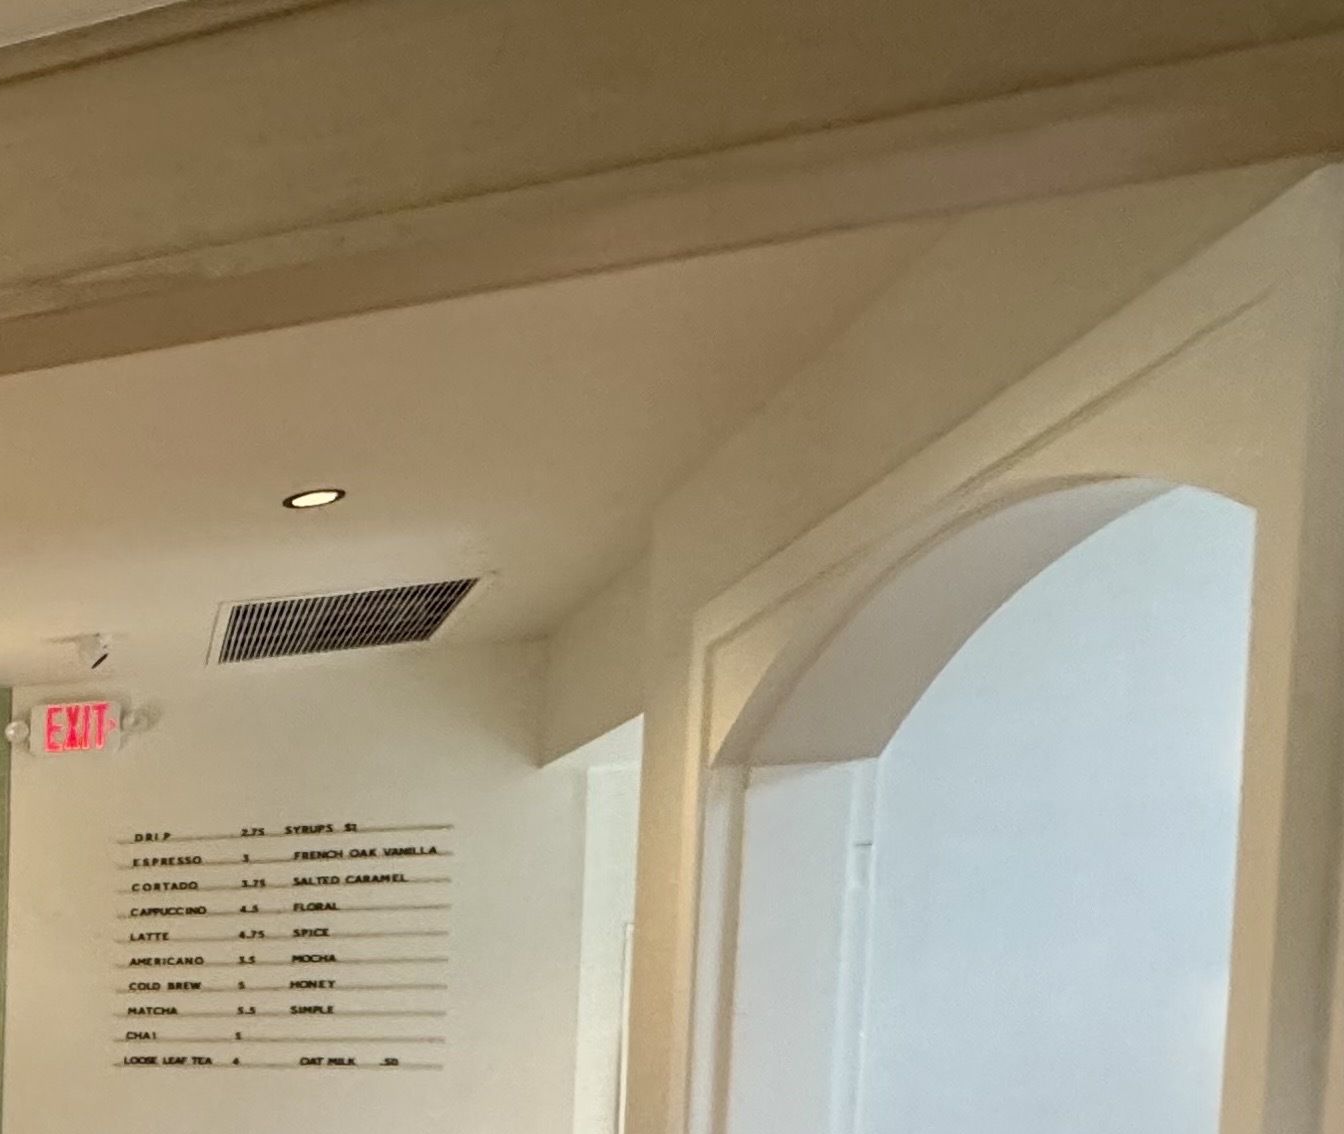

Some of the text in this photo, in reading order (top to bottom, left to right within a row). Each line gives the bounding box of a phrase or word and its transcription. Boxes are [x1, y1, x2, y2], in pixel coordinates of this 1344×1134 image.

[45, 703, 109, 752] EXIT
[284, 824, 333, 834] SYRUPS
[134, 828, 265, 842] DRIP 2.75
[293, 846, 438, 860] FRENCH OAK VANILLA
[132, 854, 250, 867] ESPRESSO 3
[292, 874, 408, 886] SALTED CARAMEL
[131, 879, 266, 892] CORTADO 3.75
[130, 905, 259, 917] CAPPUCCINO 4.5
[293, 902, 339, 912] FLORAL
[129, 930, 265, 942] LATTE 4.75
[292, 928, 330, 937] SPICE
[129, 957, 204, 966] AMERICANO
[291, 954, 336, 963] MOCHA
[128, 982, 161, 991] COLD
[167, 981, 202, 990] BREW
[289, 980, 336, 989] HONEY
[127, 1006, 178, 1015] MATCHA
[290, 1005, 334, 1014] SIMPLE
[125, 1031, 157, 1040] CHAI
[123, 1056, 158, 1065] LOOSE
[162, 1056, 188, 1065] LEAF
[191, 1056, 213, 1065] TEA
[299, 1057, 324, 1066] OAT
[327, 1057, 356, 1066] MILK
